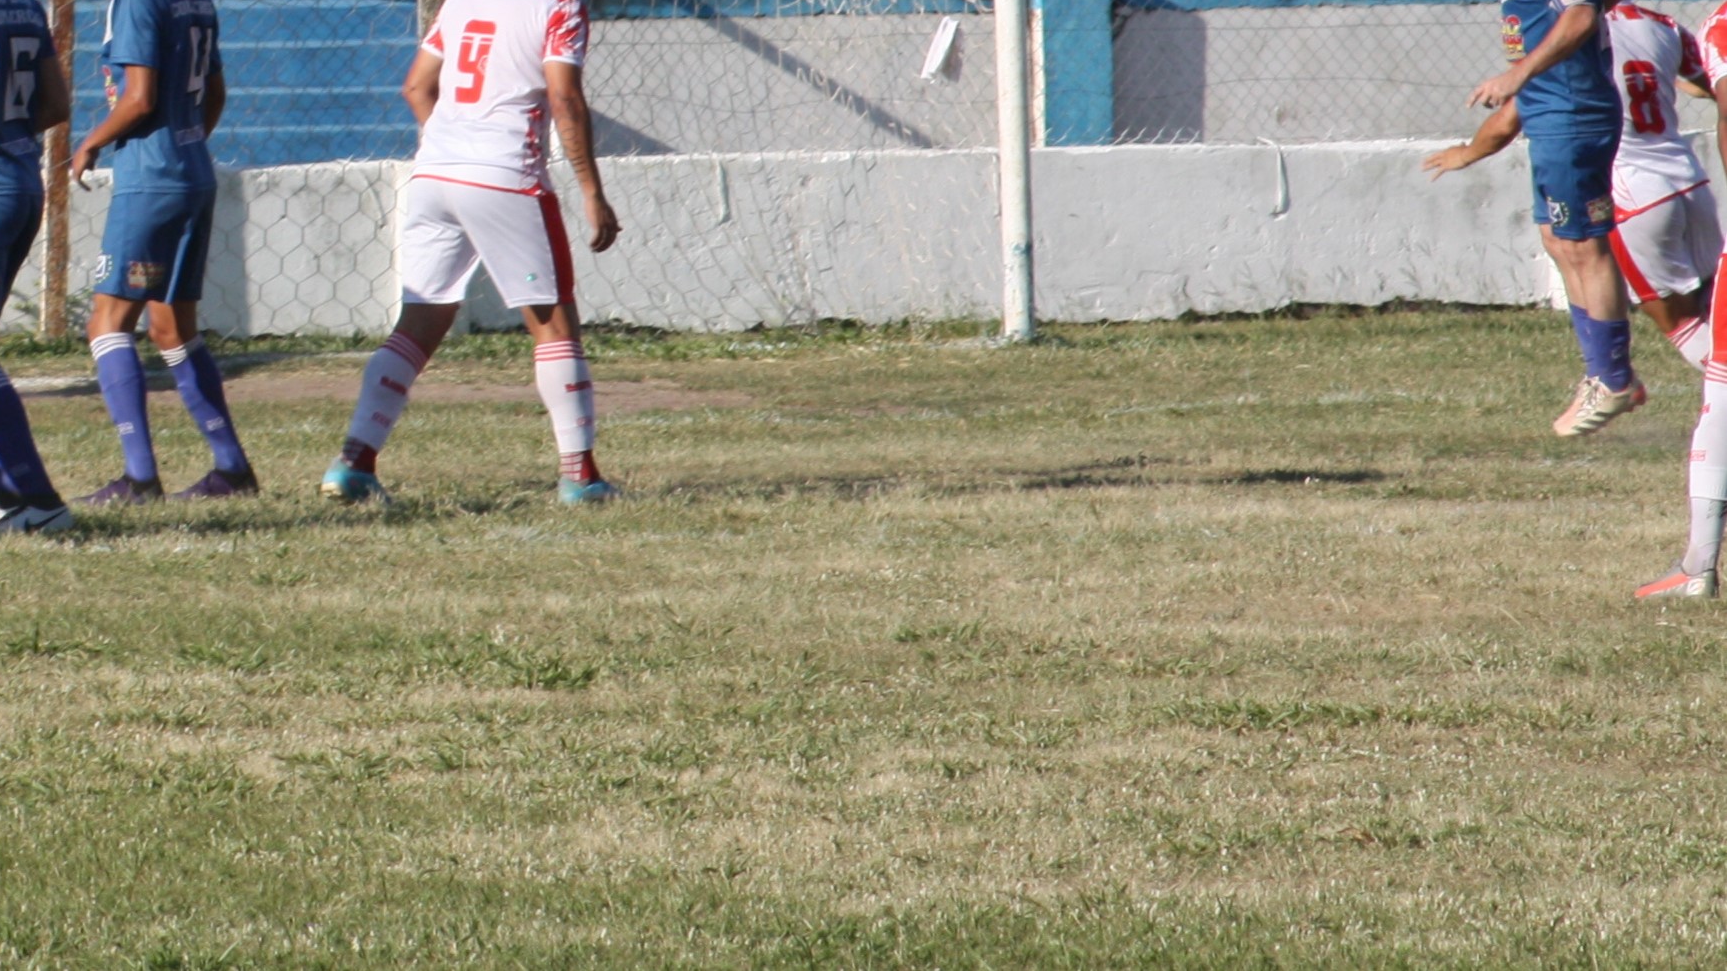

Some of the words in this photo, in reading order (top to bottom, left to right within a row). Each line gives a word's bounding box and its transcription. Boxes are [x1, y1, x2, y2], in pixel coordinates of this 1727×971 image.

[3, 37, 40, 121] 6
[187, 26, 213, 106] 4
[455, 19, 497, 104] 9
[1623, 60, 1666, 135] 8
